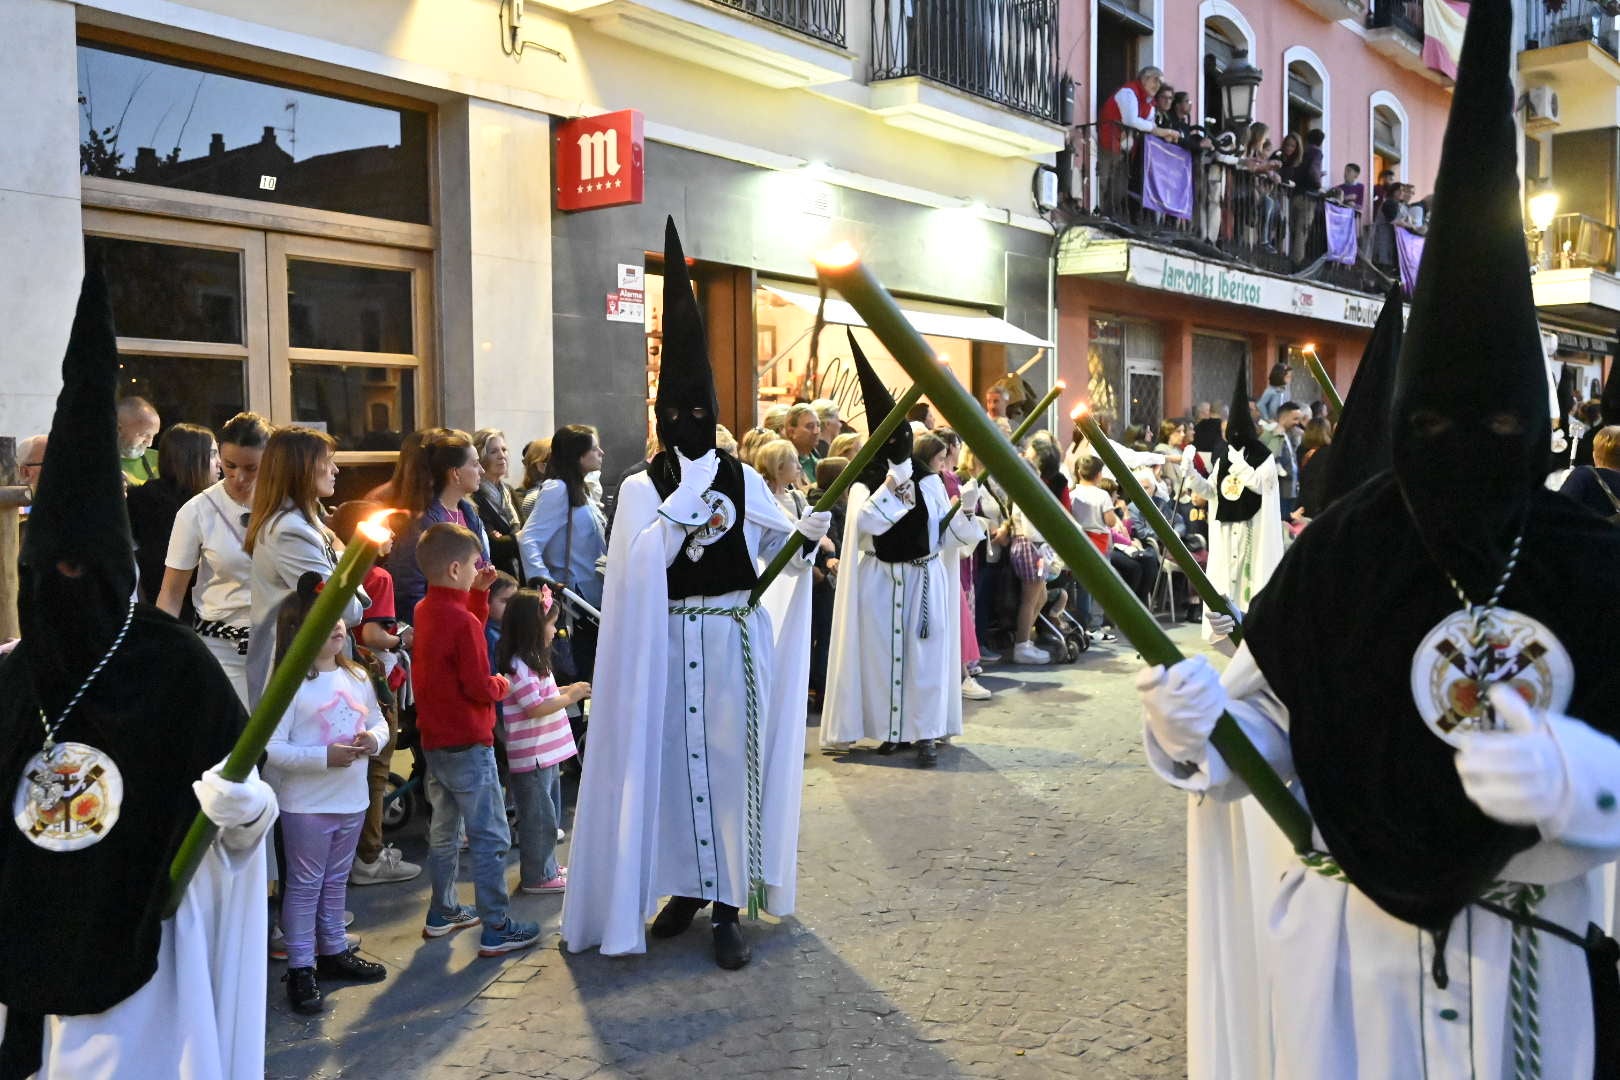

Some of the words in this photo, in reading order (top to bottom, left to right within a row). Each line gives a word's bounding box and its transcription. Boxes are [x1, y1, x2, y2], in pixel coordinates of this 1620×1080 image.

[263, 177, 275, 189] 10
[1161, 258, 1214, 295] Jamones
[1219, 271, 1261, 304] Ibéricos
[619, 289, 643, 299] Alarma
[1344, 297, 1380, 325] Embutid
